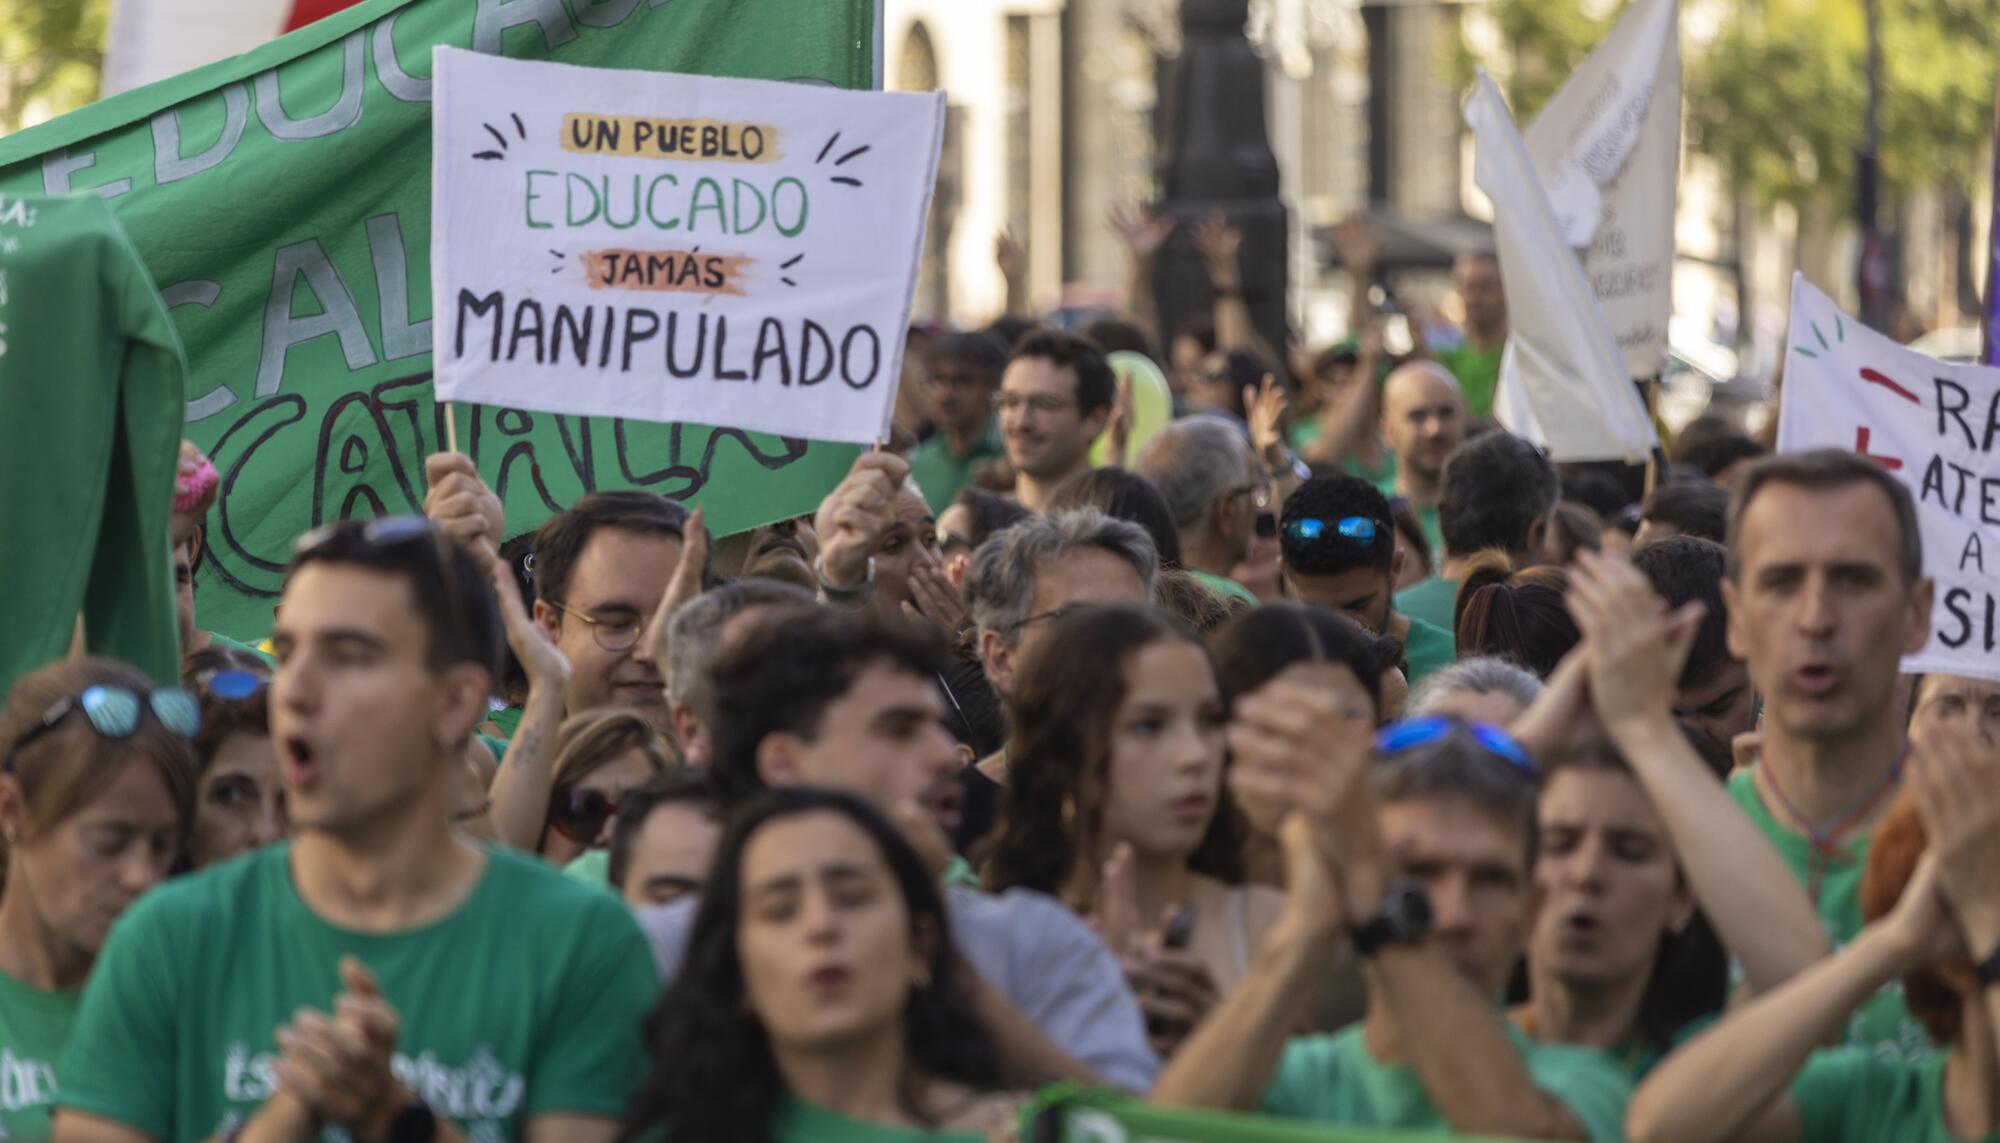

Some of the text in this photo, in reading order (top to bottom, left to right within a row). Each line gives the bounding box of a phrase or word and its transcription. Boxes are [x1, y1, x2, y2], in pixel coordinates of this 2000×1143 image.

[572, 118, 764, 160] UN PUEBLO
[525, 170, 809, 238] EDUCADO
[602, 245, 725, 288] JAMÁS
[455, 288, 881, 389] MANIPULADO
